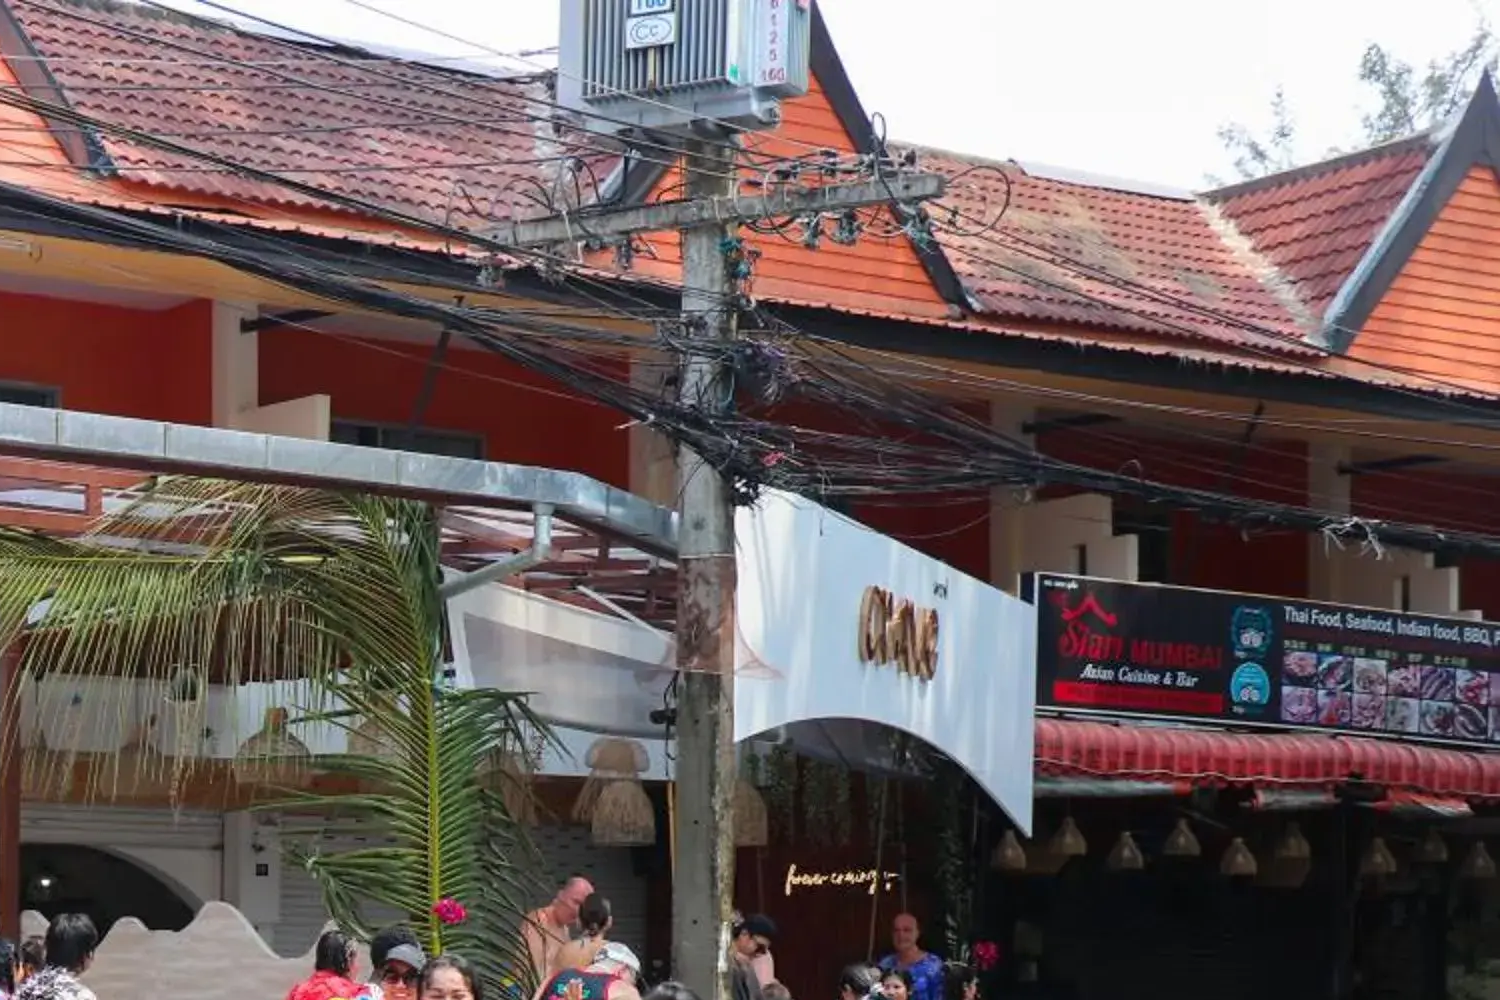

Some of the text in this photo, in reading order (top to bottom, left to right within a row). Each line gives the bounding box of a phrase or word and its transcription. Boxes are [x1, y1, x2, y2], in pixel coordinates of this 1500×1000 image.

[1284, 605, 1310, 624] Thai
[1311, 609, 1343, 630] Food,
[1345, 612, 1395, 635] Seafood,
[1397, 619, 1431, 637] Indian
[1433, 623, 1461, 644] food,
[1131, 638, 1222, 671] MUMBAI
[1080, 663, 1199, 688] Asian Cuisine & Bar
